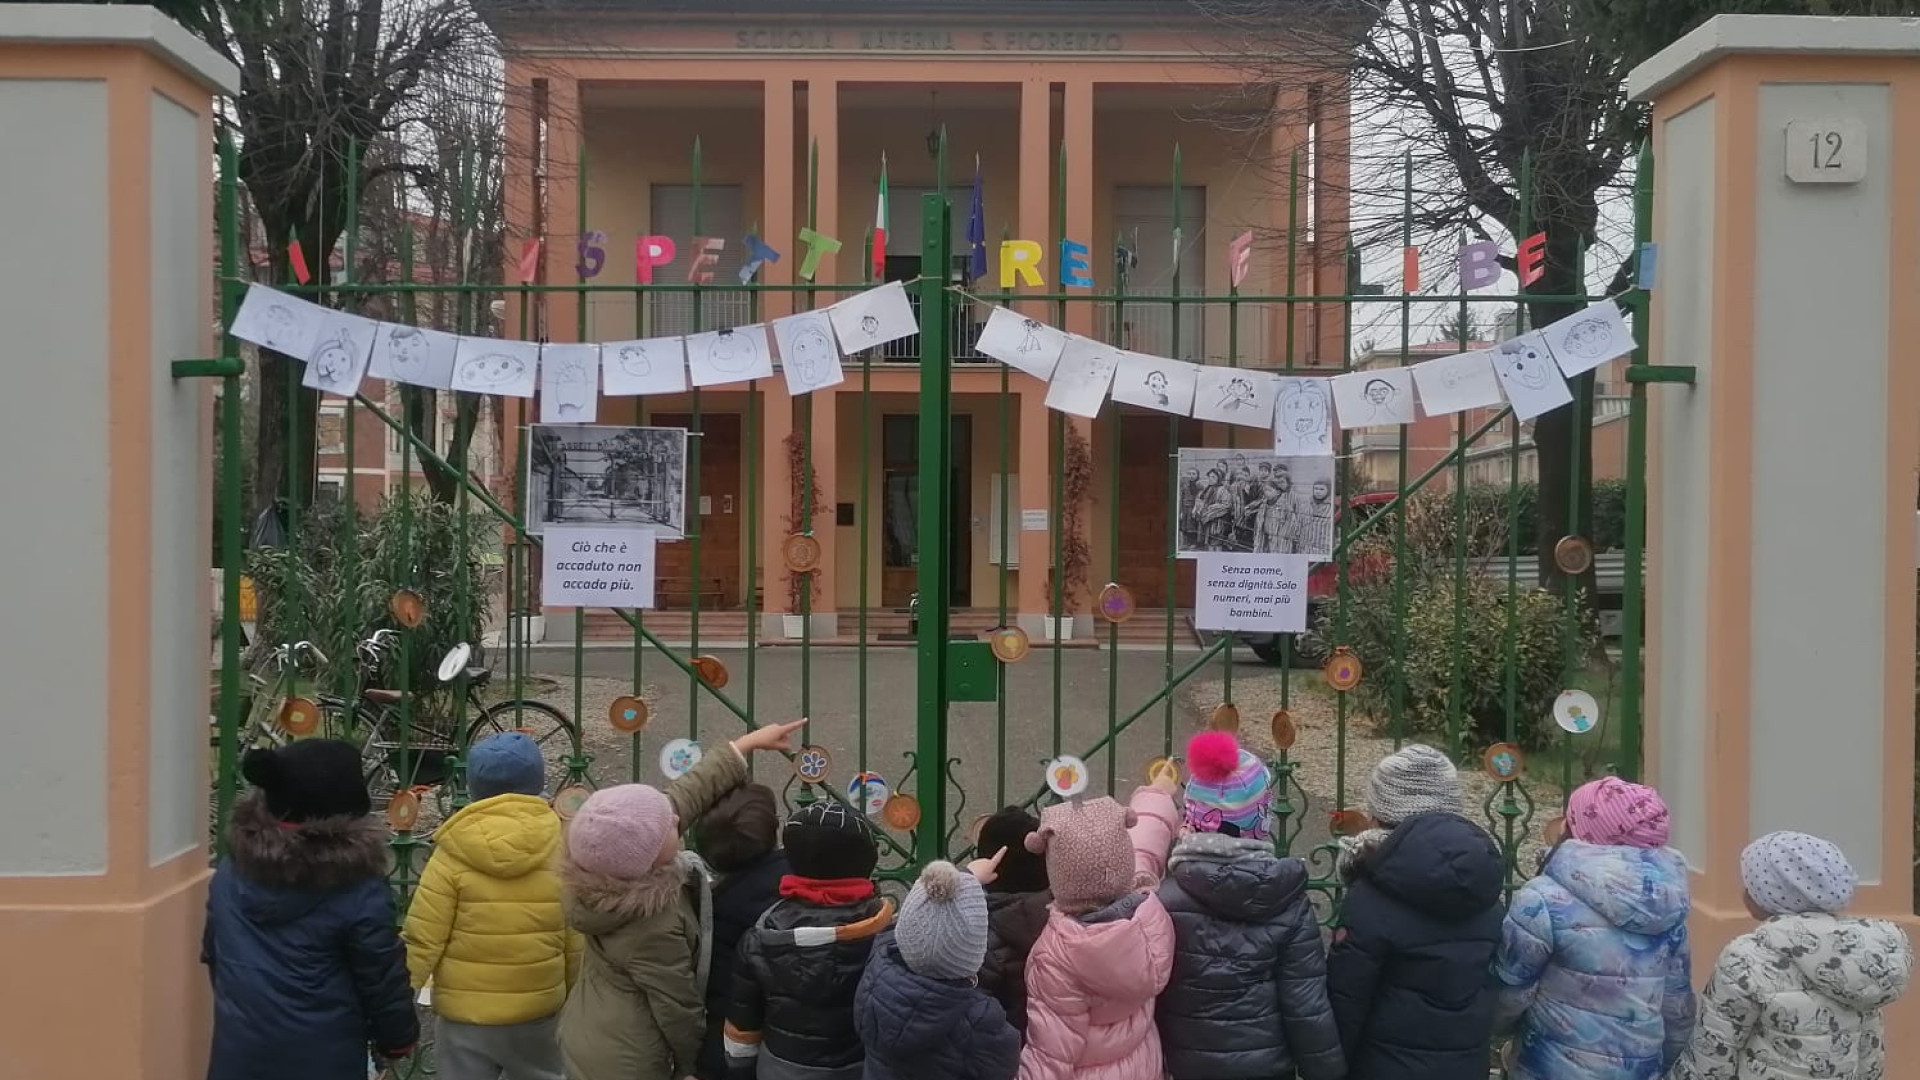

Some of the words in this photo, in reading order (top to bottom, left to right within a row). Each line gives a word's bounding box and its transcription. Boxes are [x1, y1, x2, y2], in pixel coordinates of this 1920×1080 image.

[736, 29, 835, 49] SCUOLA
[1809, 131, 1843, 169] 12
[571, 541, 591, 553] Ciò
[594, 542, 617, 554] che
[619, 542, 627, 554] è
[556, 560, 614, 572] accaduto
[617, 563, 642, 573] non
[1221, 565, 1251, 575] Senza
[1253, 567, 1283, 577] nome,
[563, 578, 607, 590] accada
[610, 578, 634, 592] più.
[1207, 580, 1236, 589] senza
[1213, 594, 1251, 604] numeri,
[1253, 595, 1273, 604] mai
[1274, 595, 1291, 606] più
[1229, 608, 1273, 618] bambini.
